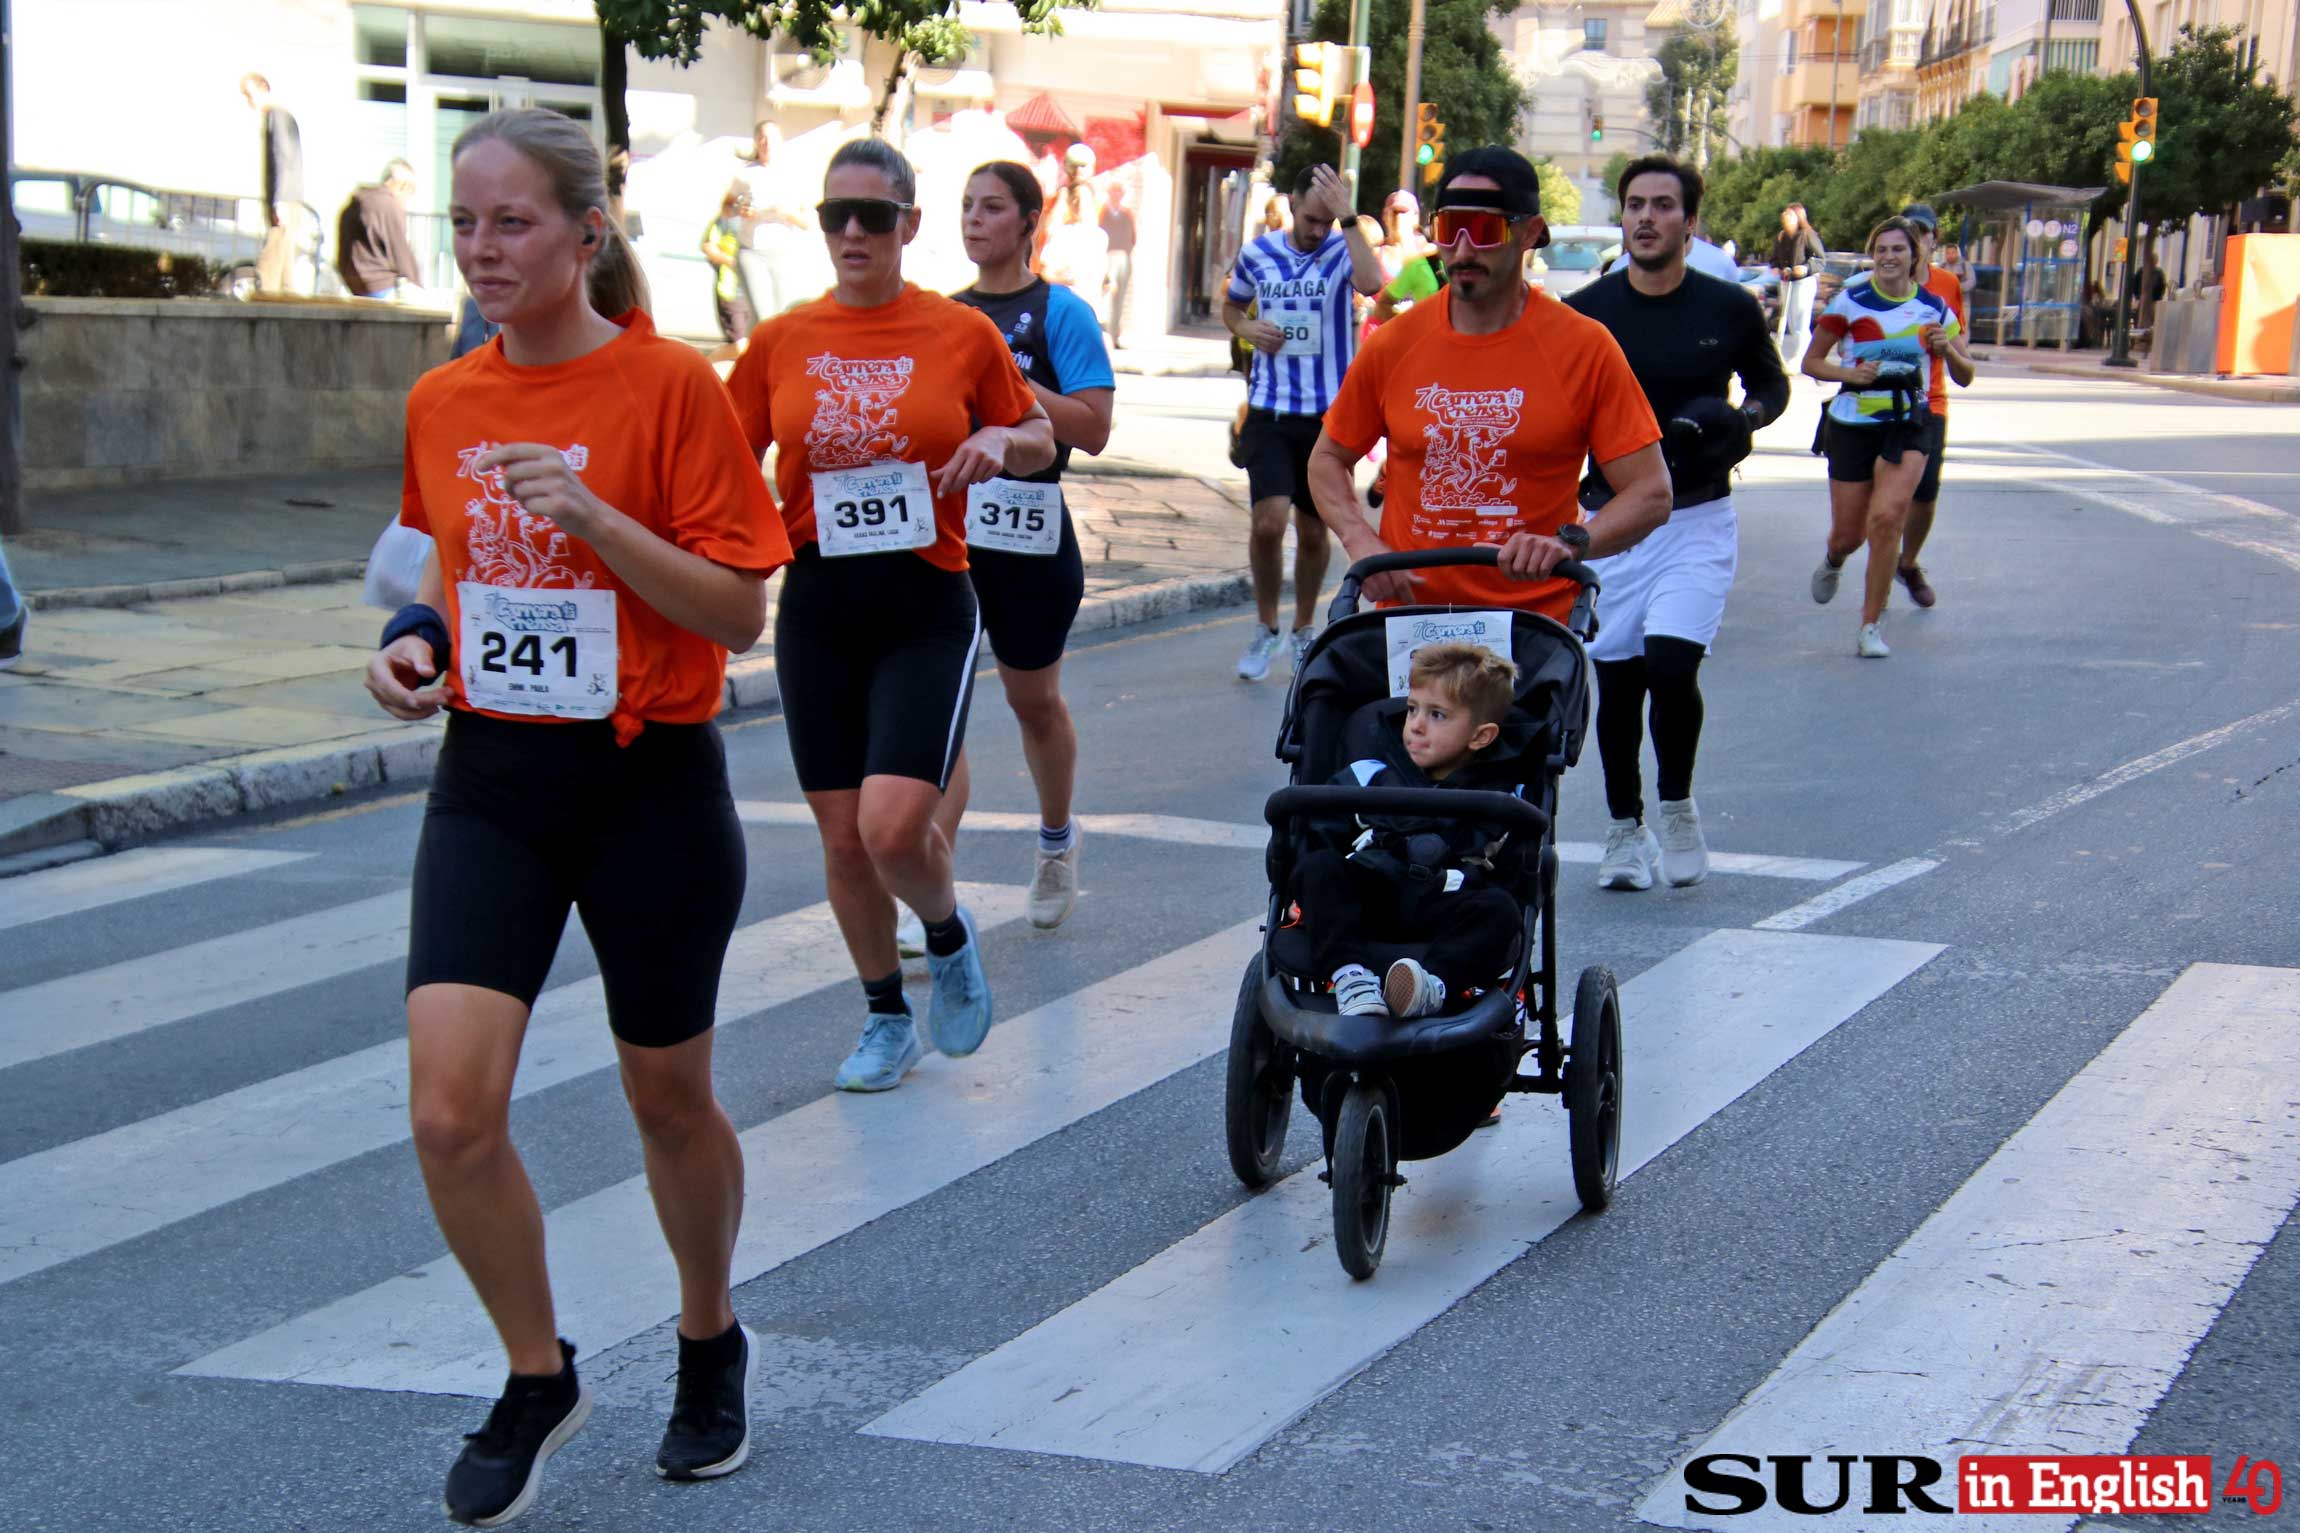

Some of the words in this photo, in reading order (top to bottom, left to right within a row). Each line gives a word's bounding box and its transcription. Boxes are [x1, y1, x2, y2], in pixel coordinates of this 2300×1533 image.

[1275, 325, 1309, 341] 60
[824, 357, 896, 375] Carrera
[1432, 389, 1506, 407] Carrera
[1438, 404, 1510, 421] Prensa
[834, 495, 909, 528] 391
[979, 501, 1045, 531] 315
[481, 631, 577, 677] 241
